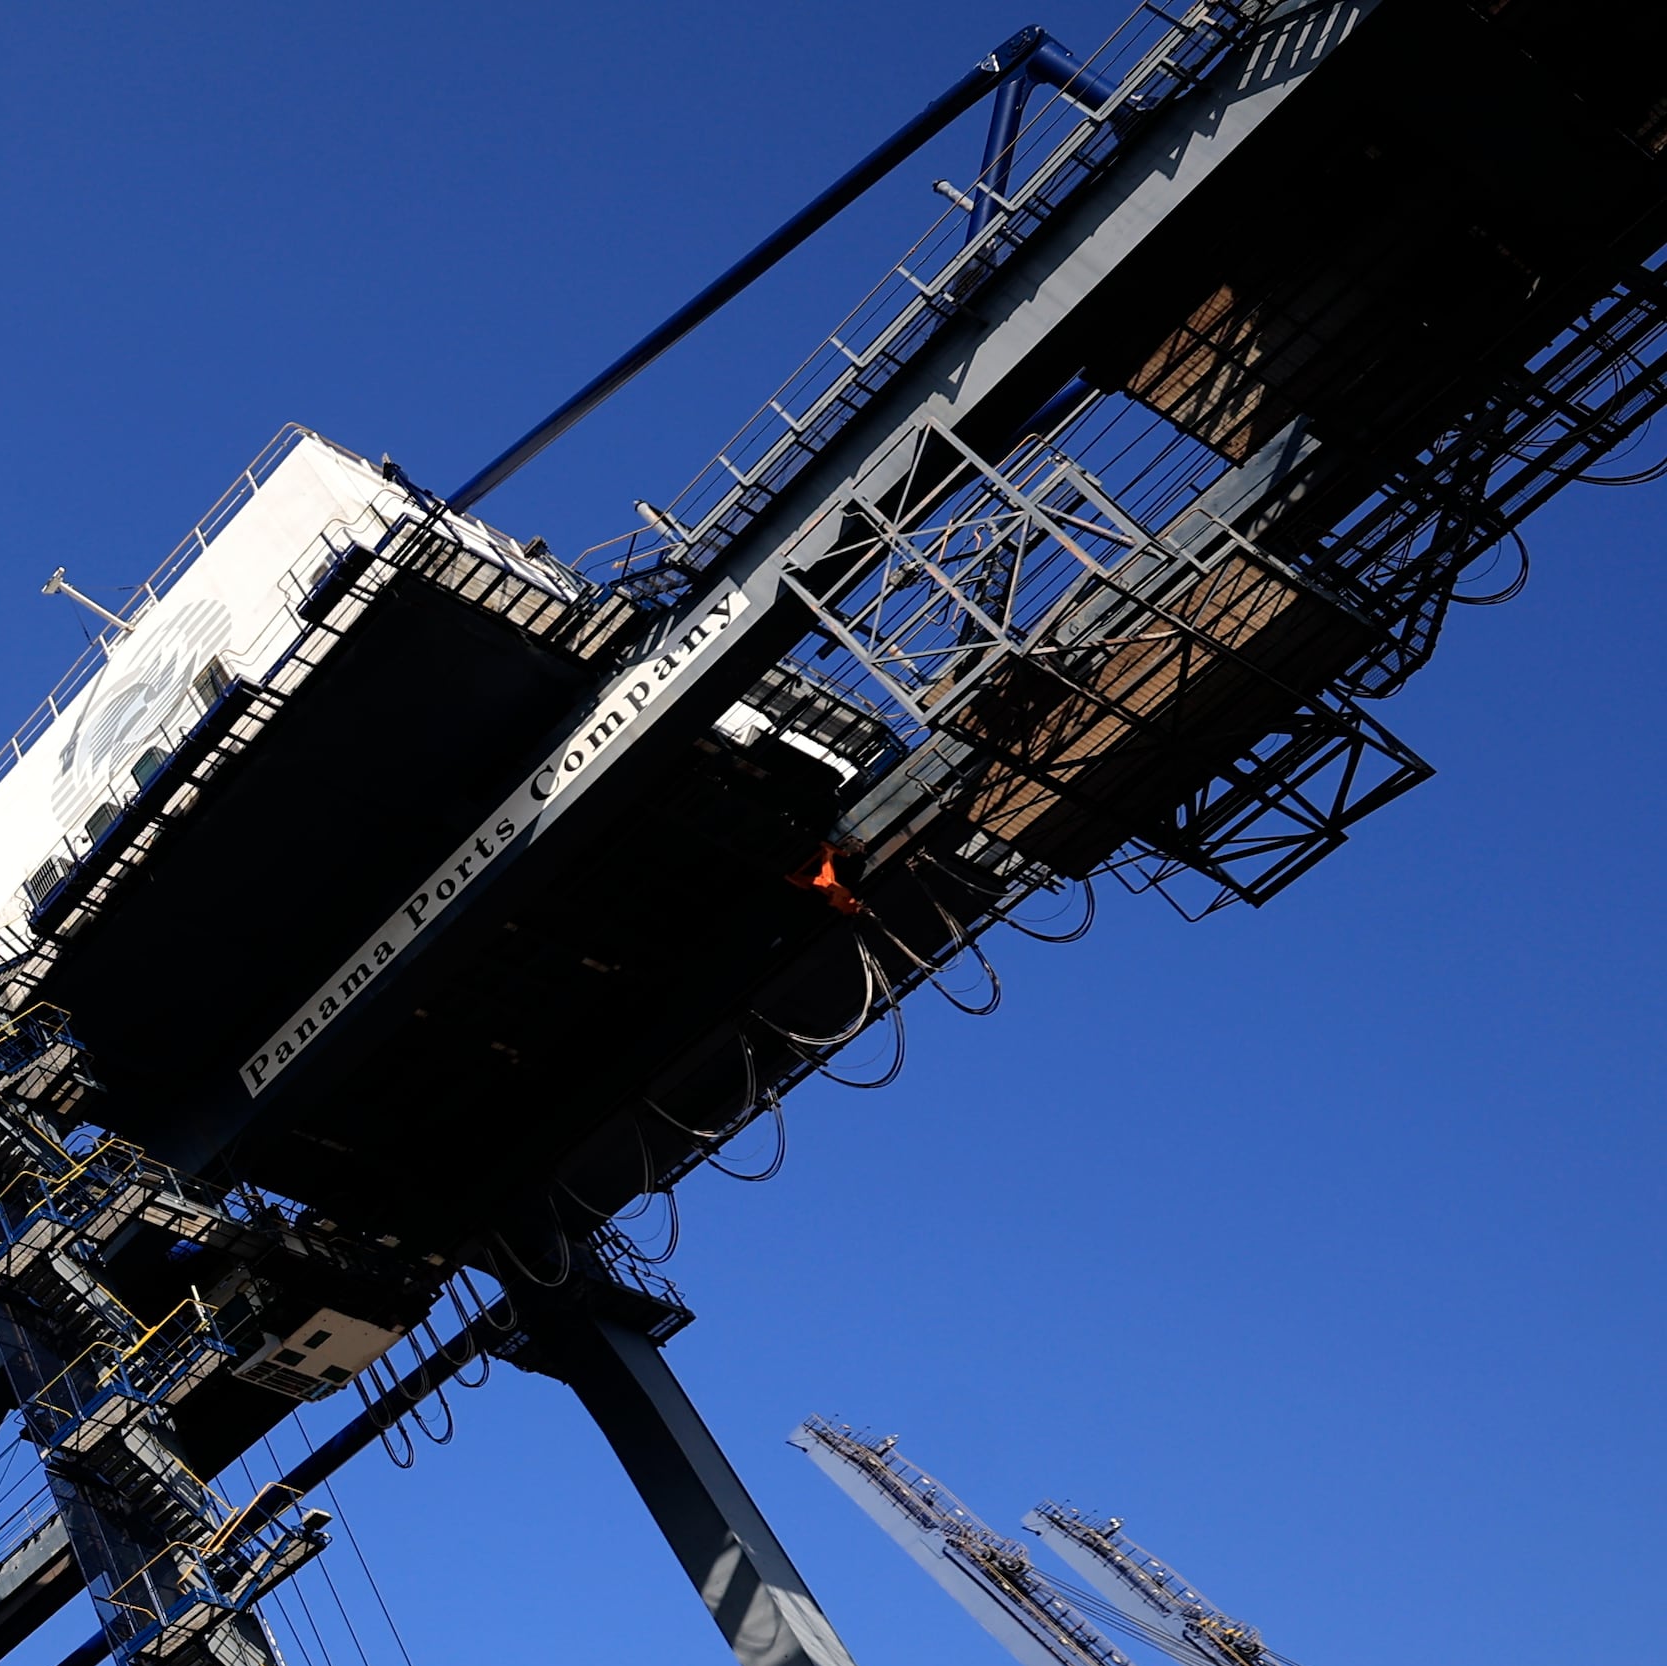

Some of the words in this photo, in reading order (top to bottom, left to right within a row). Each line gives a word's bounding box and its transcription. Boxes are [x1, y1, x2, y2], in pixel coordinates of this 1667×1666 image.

[245, 939, 397, 1091] Panama
[402, 817, 515, 932] Ports
[529, 591, 734, 803] Company
